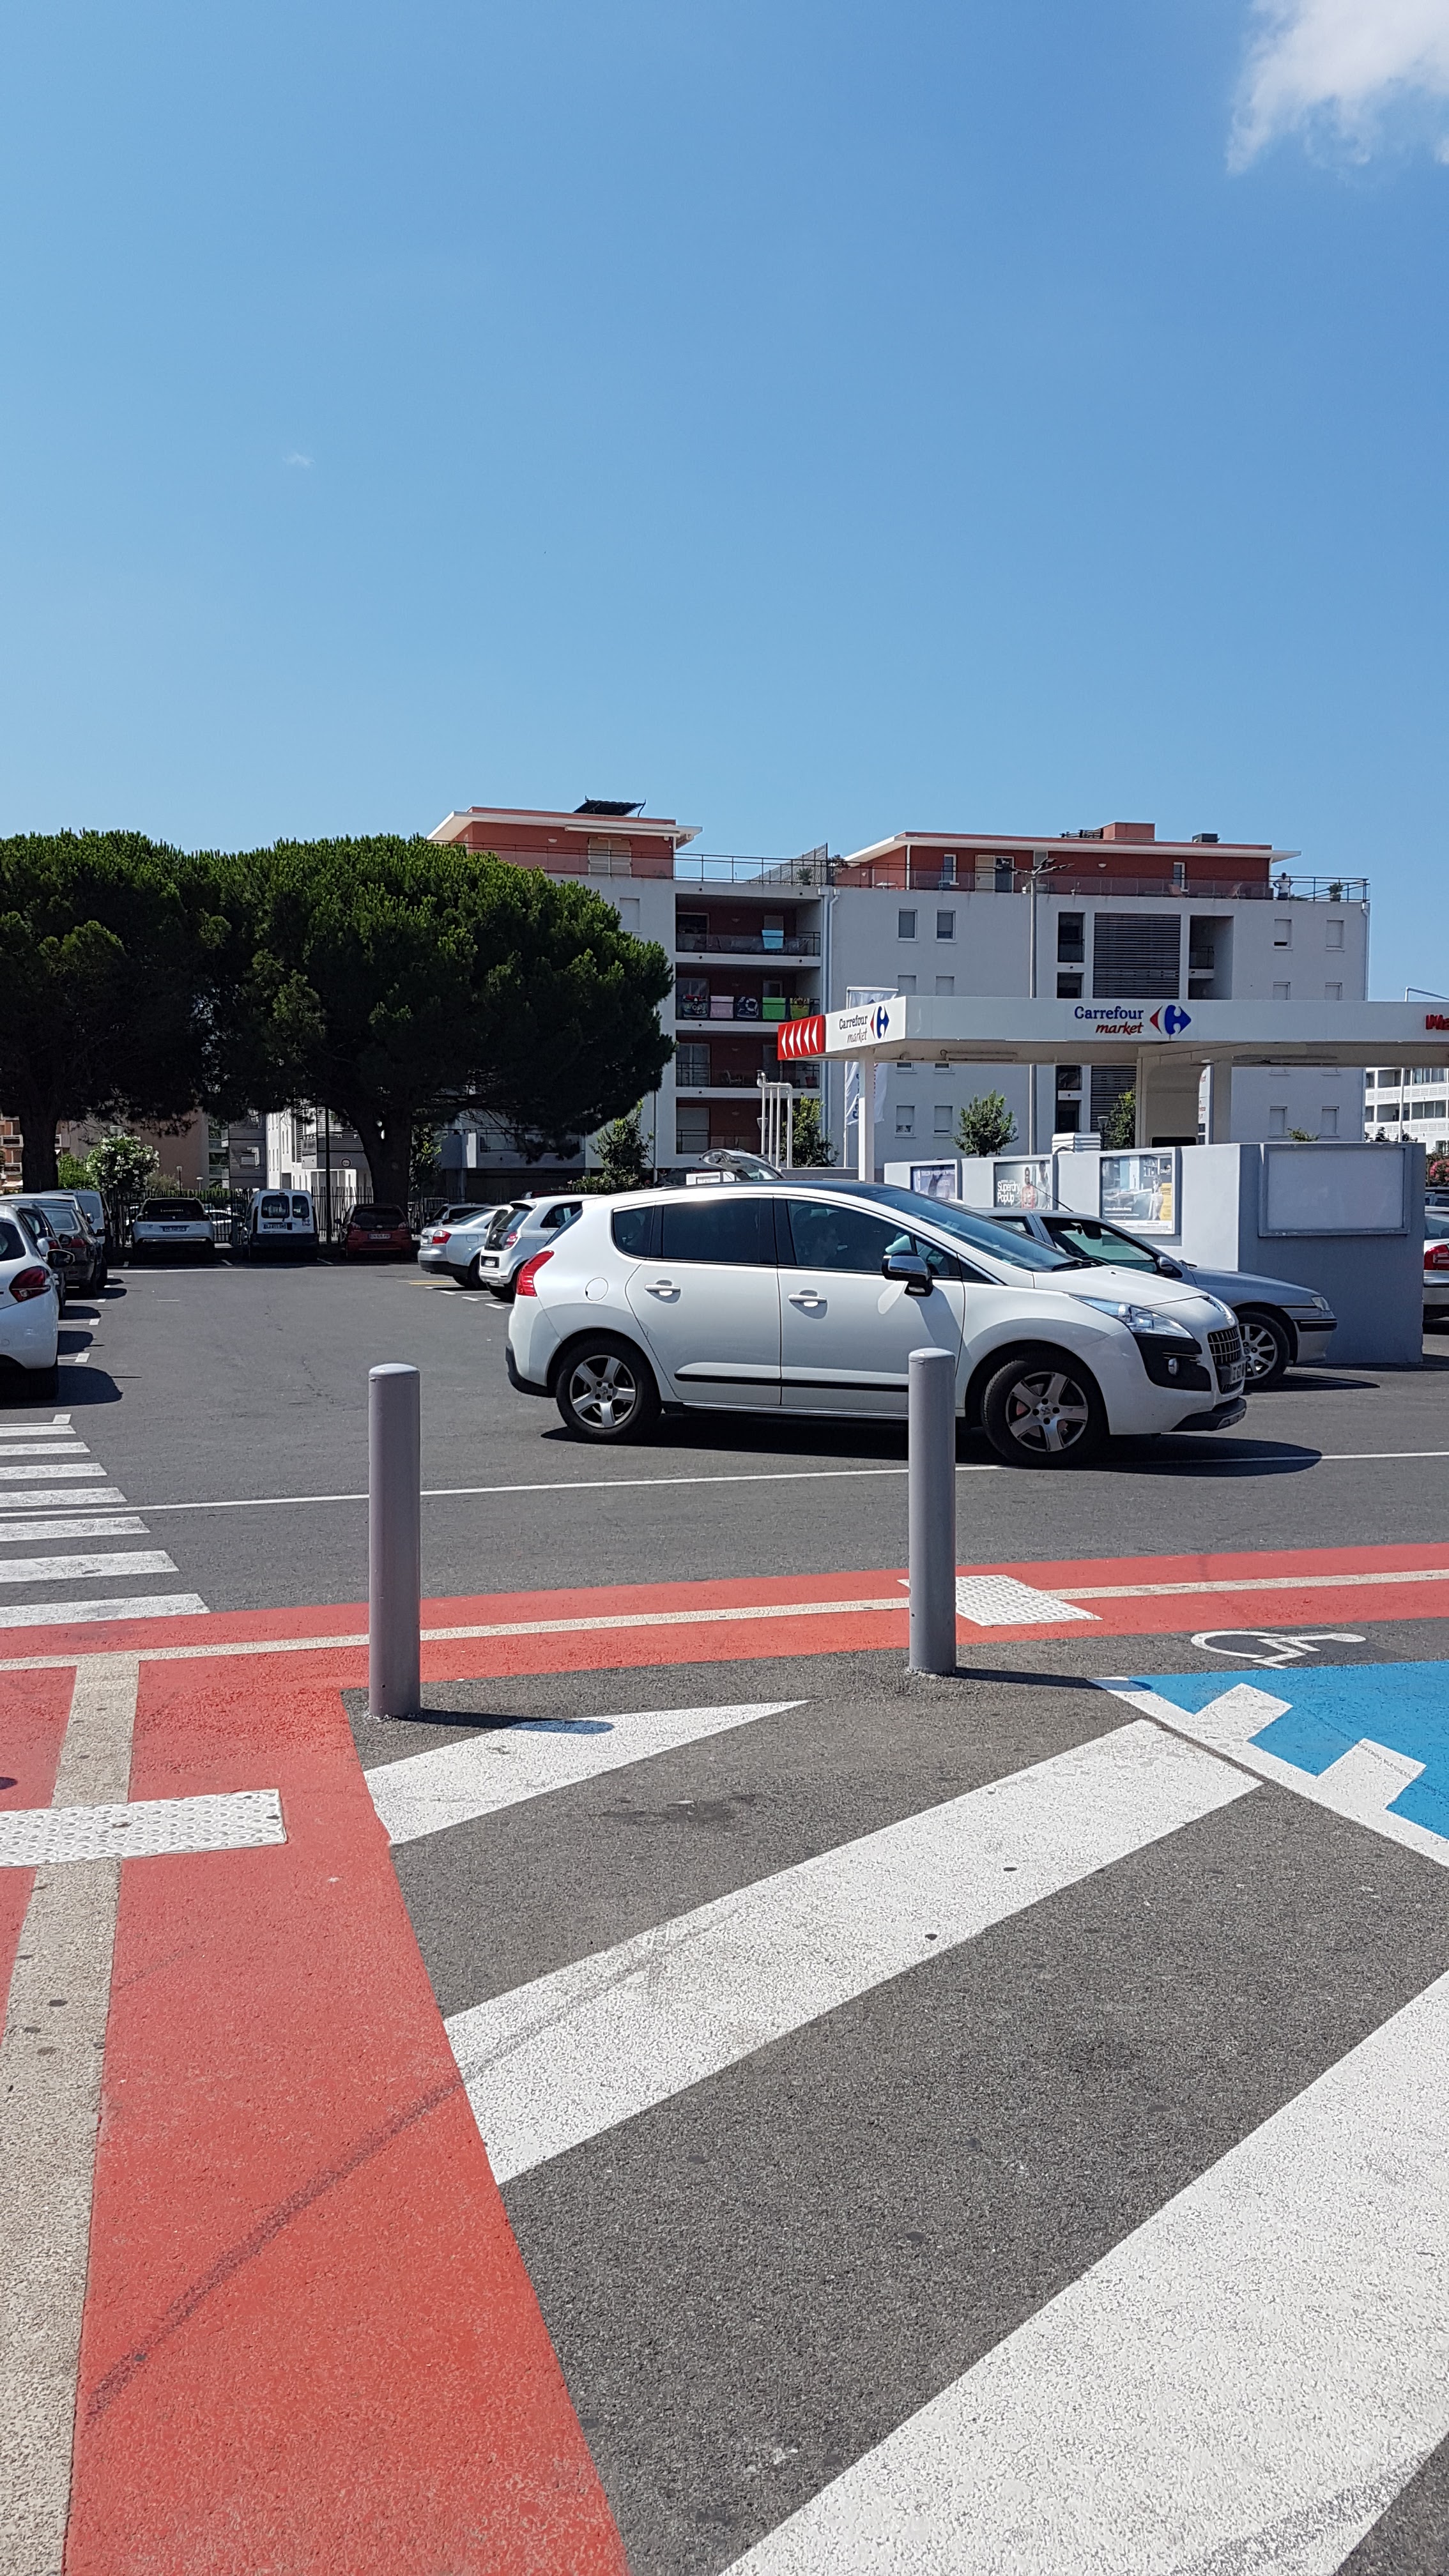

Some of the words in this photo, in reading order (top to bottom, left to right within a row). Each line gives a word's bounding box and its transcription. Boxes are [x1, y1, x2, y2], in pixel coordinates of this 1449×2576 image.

[1074, 1006, 1144, 1020] Carrefour
[839, 1014, 868, 1030] Carrefour
[1095, 1021, 1144, 1035] market
[847, 1028, 868, 1043] market
[997, 1181, 1020, 1195] Superdry
